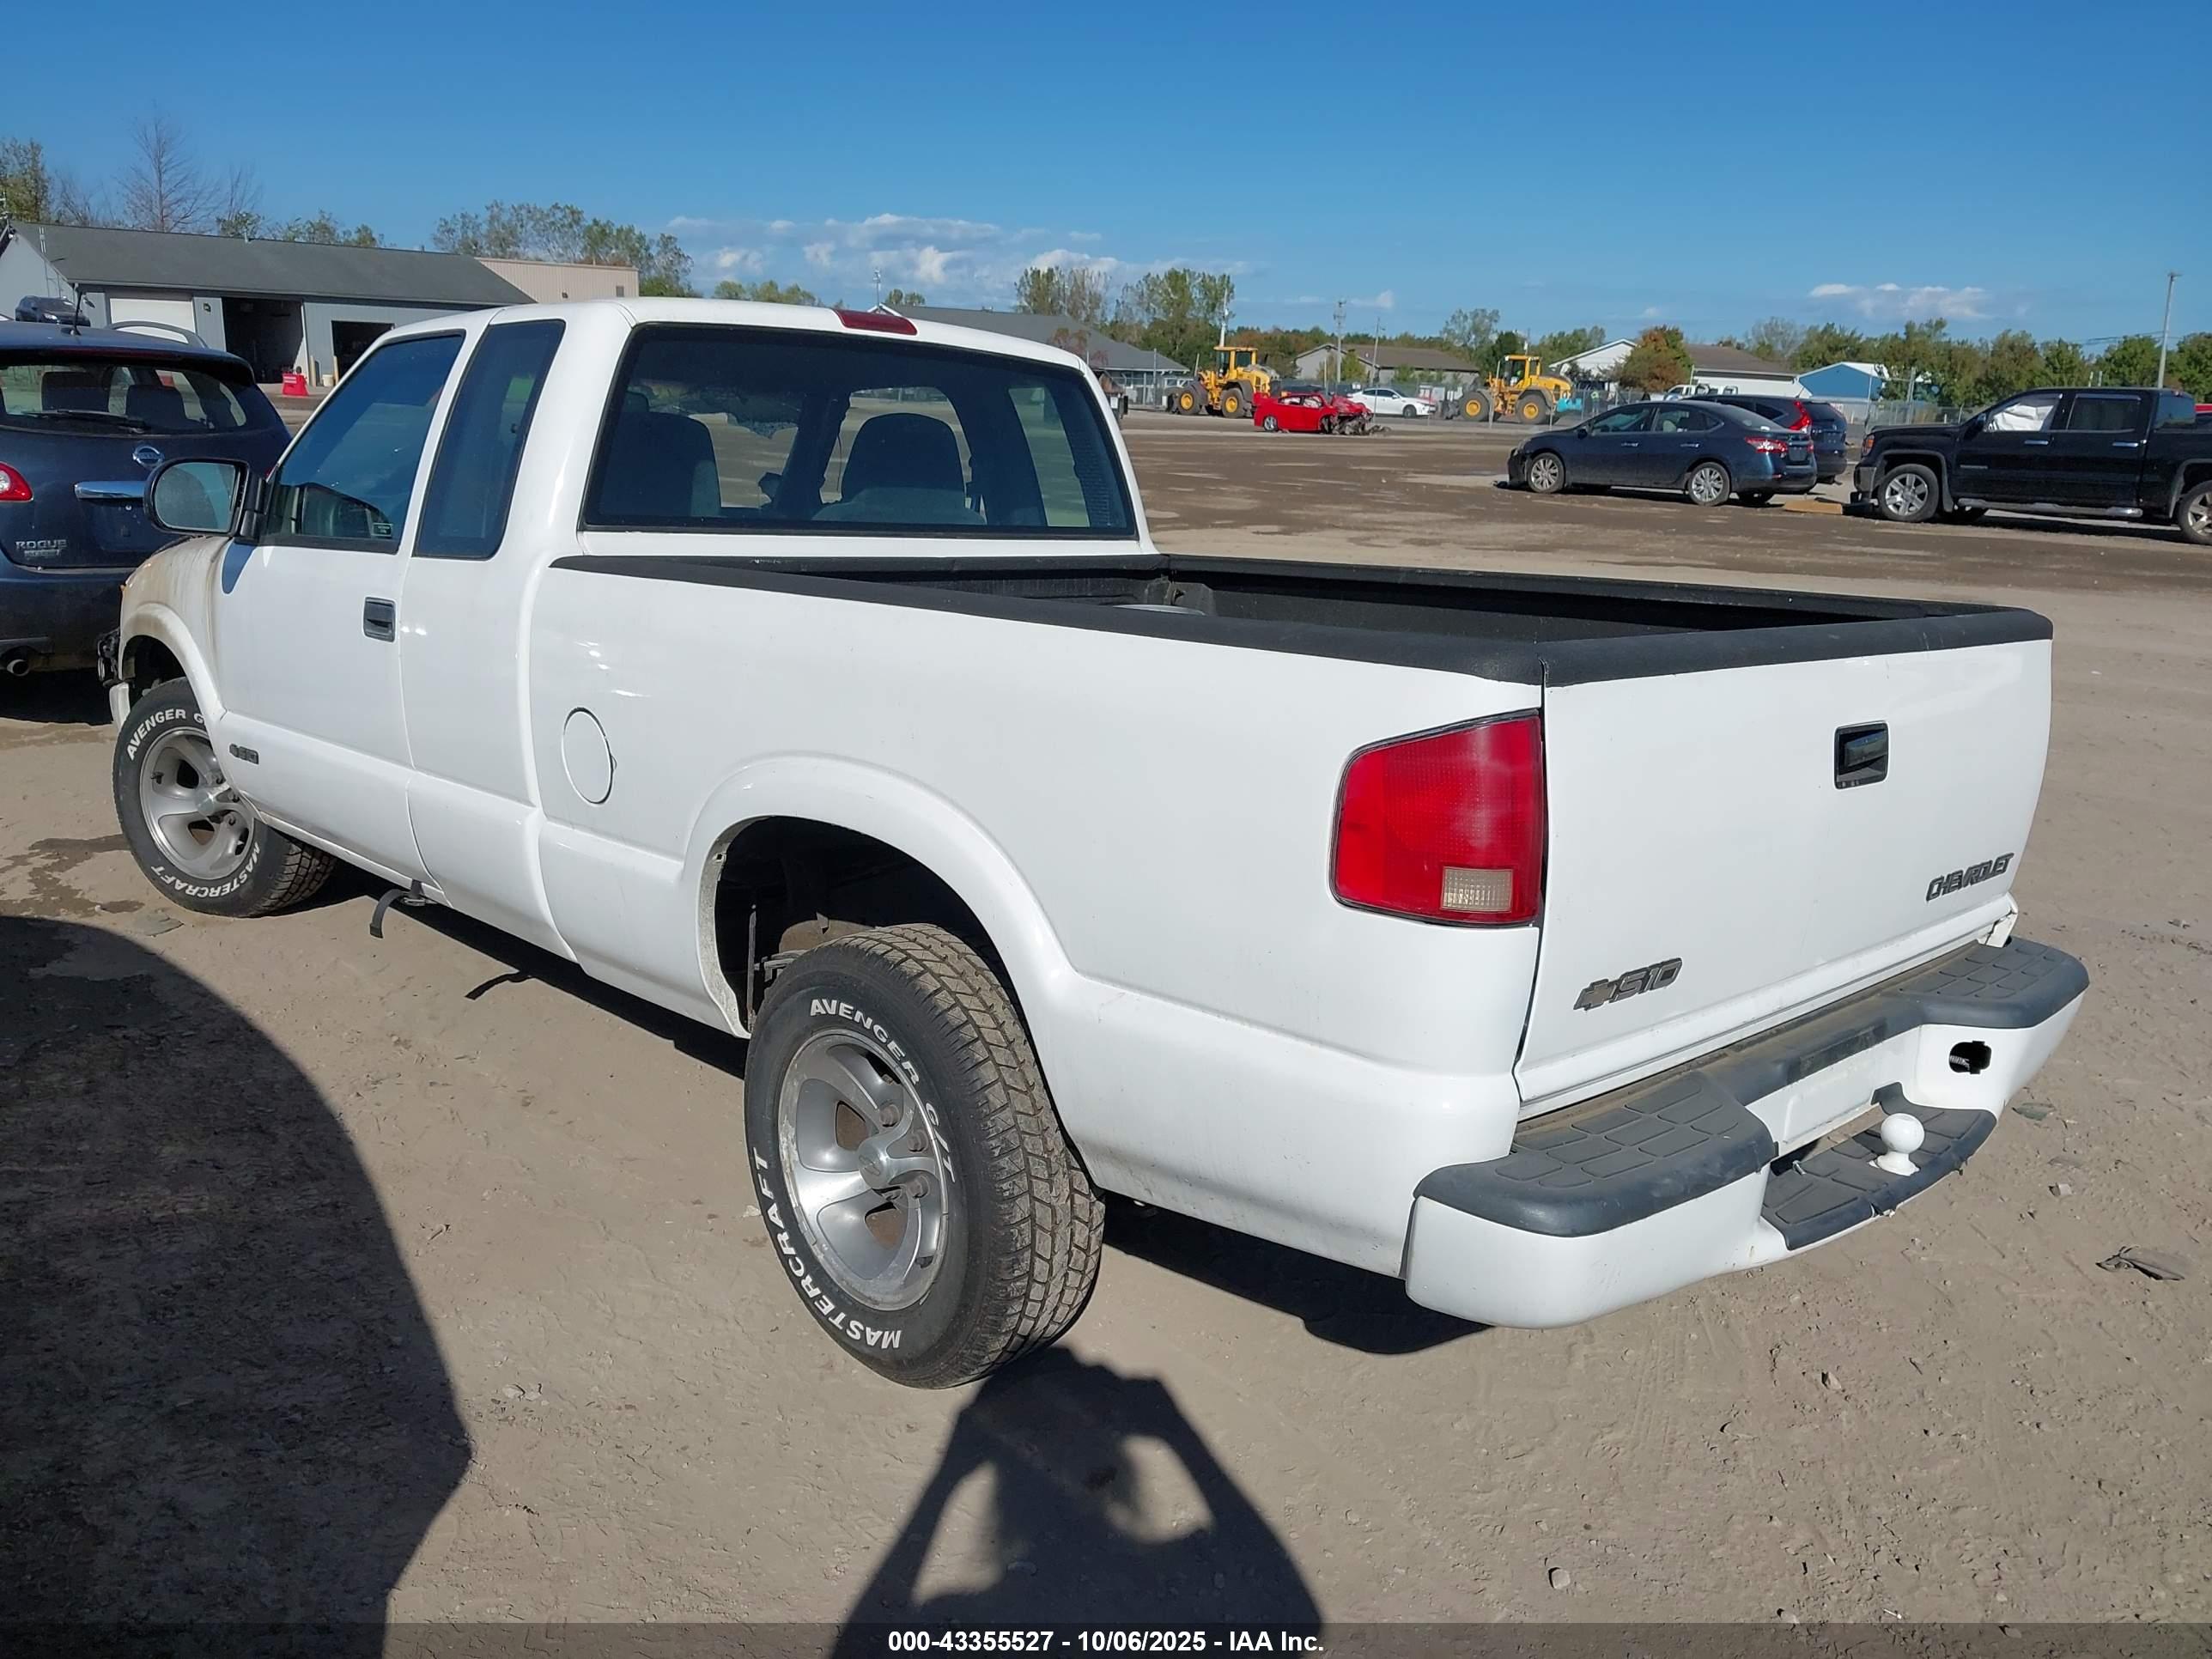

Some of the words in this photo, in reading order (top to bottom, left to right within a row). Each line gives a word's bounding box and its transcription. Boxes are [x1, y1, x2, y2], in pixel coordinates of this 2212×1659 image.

[15, 539, 67, 550] ROGUE
[126, 708, 186, 761] AVENGER
[150, 842, 261, 898] MASTERCRAFT
[1926, 853, 2014, 902] CHEVROLET
[1609, 957, 1682, 1003] S10
[810, 998, 920, 1087] AVENGER
[753, 1146, 902, 1351] MASTERCRAFT
